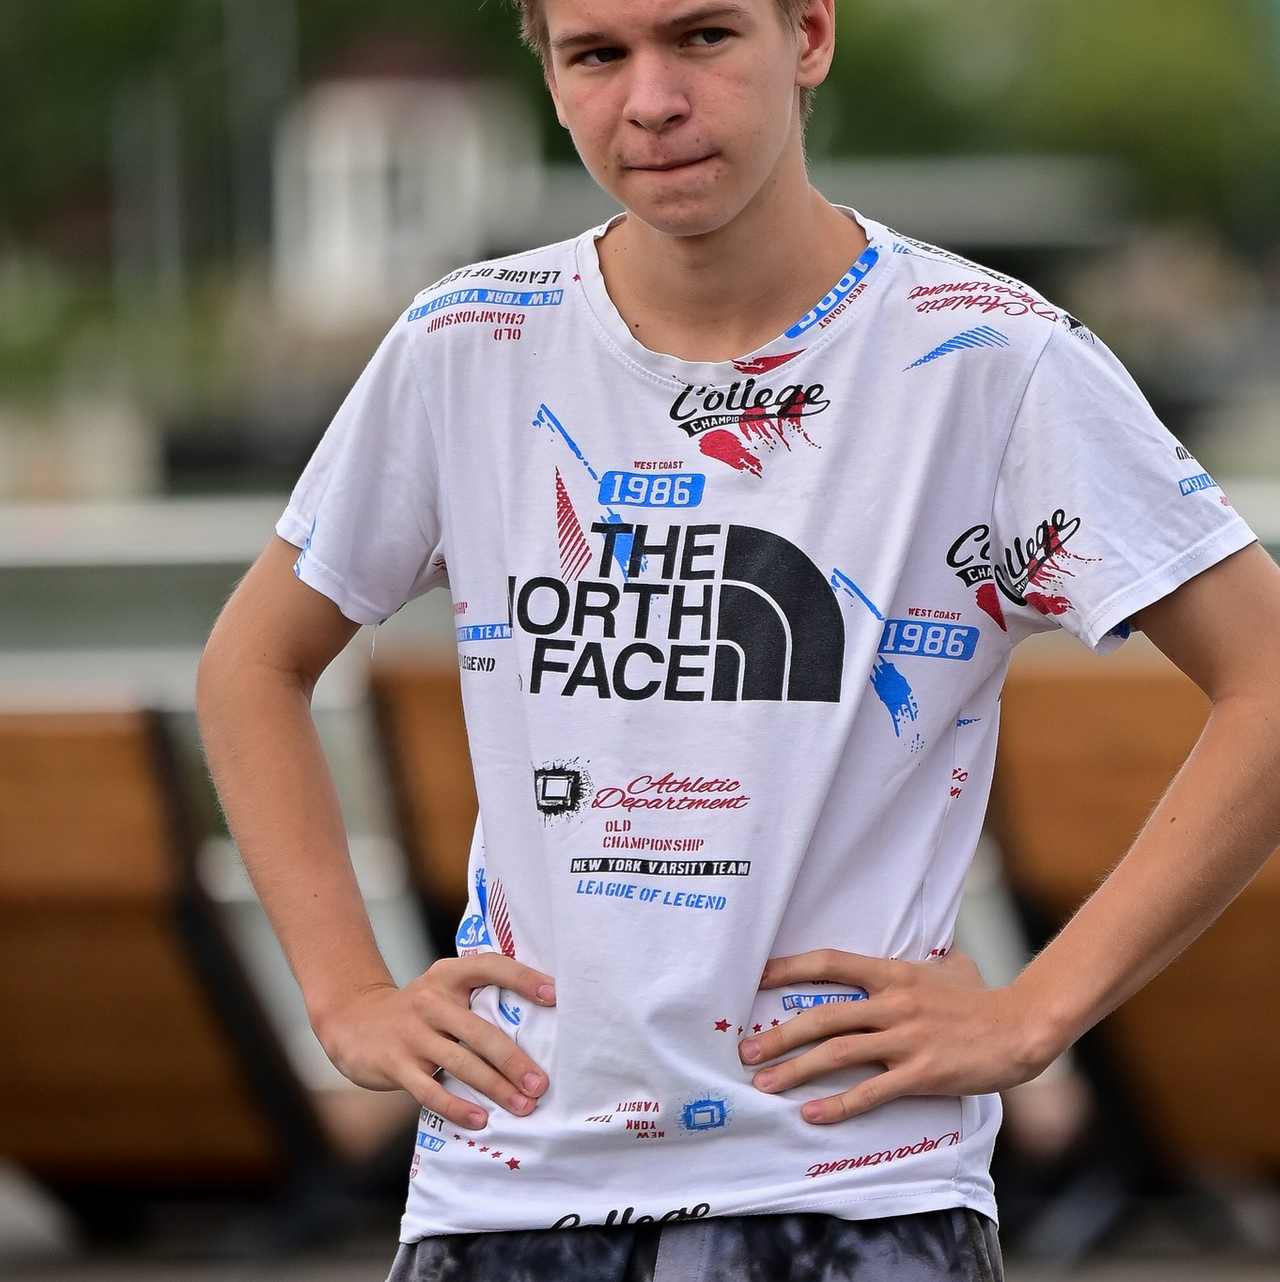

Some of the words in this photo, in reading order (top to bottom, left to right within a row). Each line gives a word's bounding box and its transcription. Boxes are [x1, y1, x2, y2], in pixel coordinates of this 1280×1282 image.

[427, 290, 479, 315] VARSITY
[485, 291, 522, 305] YORK
[528, 291, 563, 305] NEW
[848, 282, 868, 306] WEST
[818, 303, 847, 329] COAST
[915, 295, 1029, 316] Athletic
[427, 311, 526, 333] CHAMPIONSHIP
[494, 328, 522, 340] OLD
[669, 378, 831, 421] College
[634, 461, 657, 470] WEST
[659, 460, 684, 469] COAST
[610, 474, 692, 505] 1986
[590, 522, 721, 581] THE
[908, 607, 932, 619] WEST
[934, 610, 961, 620] COAST
[884, 623, 967, 657] 1986
[529, 637, 711, 702] FACE
[627, 772, 740, 794] Athletic
[591, 788, 751, 812] Department
[605, 820, 632, 832] OLD
[603, 836, 704, 851] CHAMPIONSHIP
[573, 859, 602, 872] NEW
[608, 859, 642, 872] YORK
[648, 862, 706, 875] VARSITY
[712, 862, 749, 875] TEAM
[576, 879, 637, 899] LEAGUE
[639, 887, 662, 902] OF
[663, 890, 727, 911] LEGEND
[784, 996, 815, 1009] NEW
[615, 1101, 659, 1112] VARSITY
[626, 1119, 656, 1129] YORK
[636, 1131, 664, 1139] NEW
